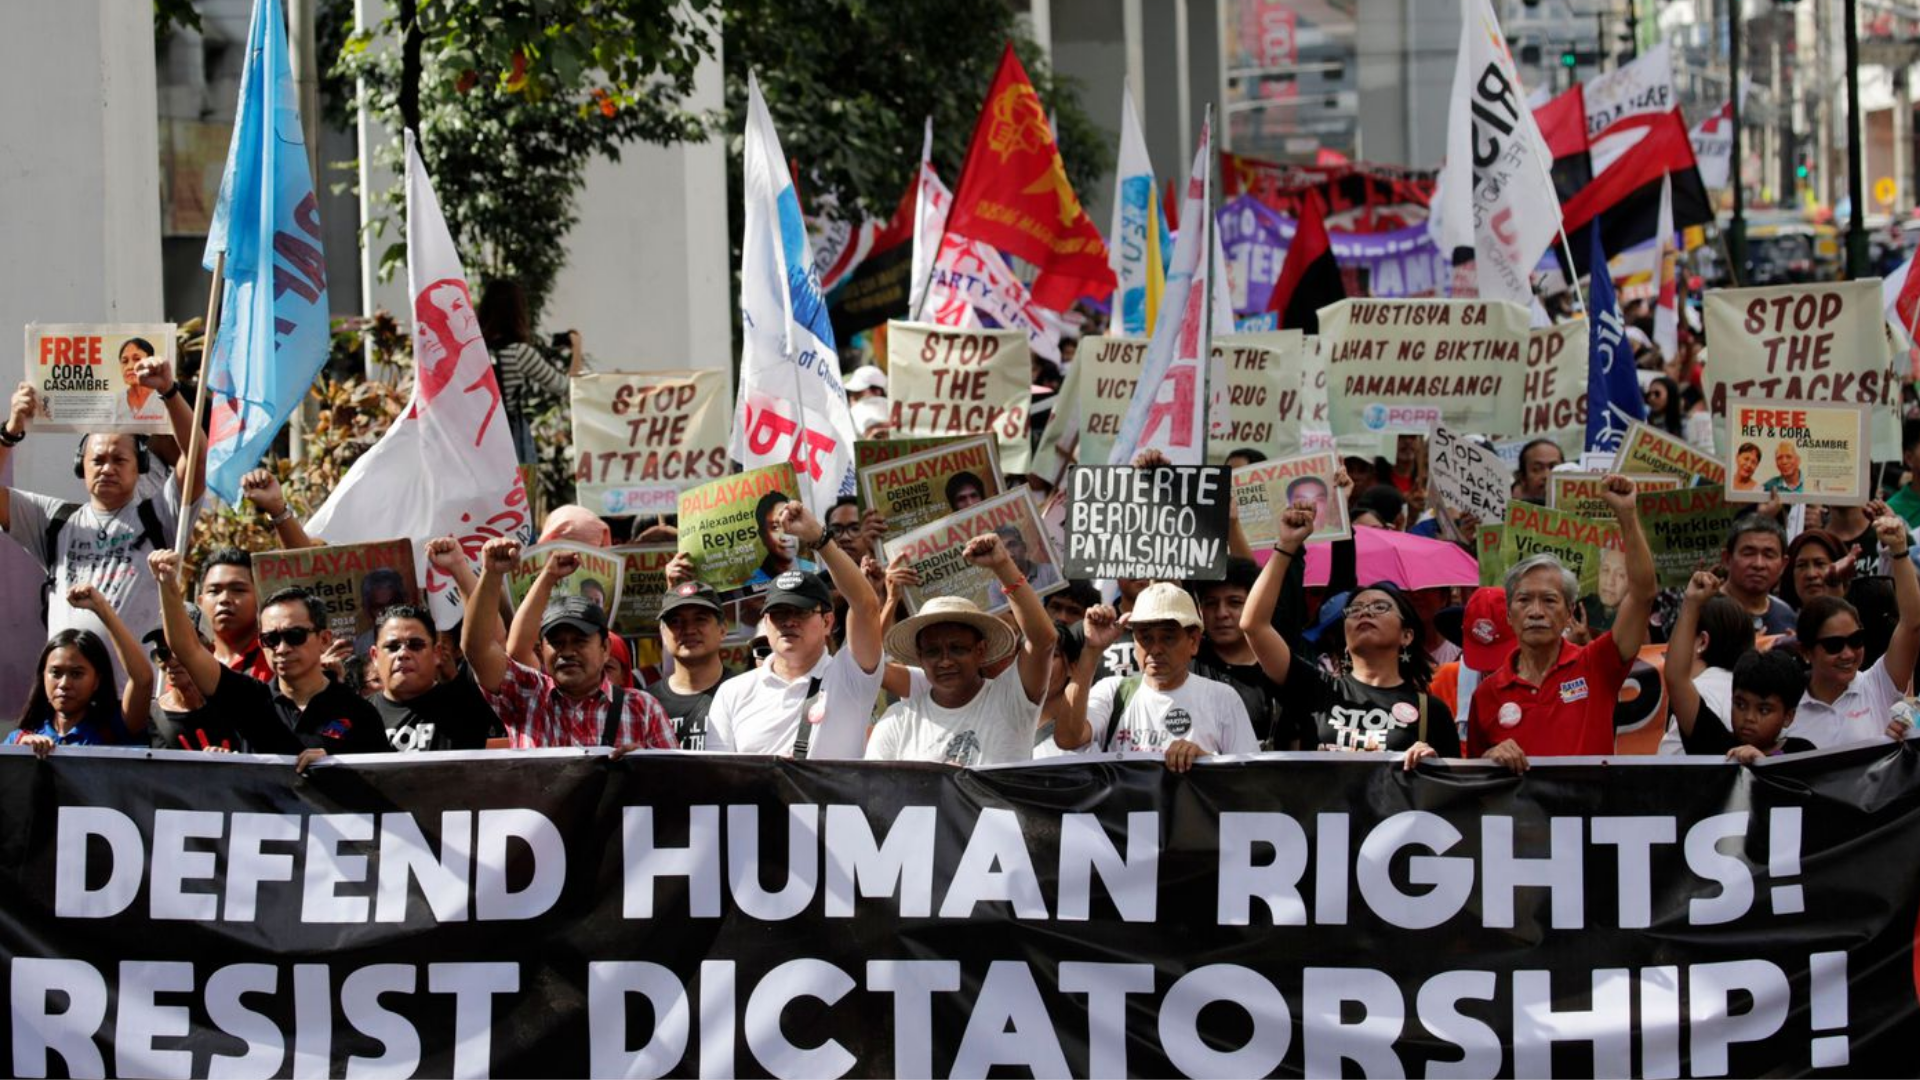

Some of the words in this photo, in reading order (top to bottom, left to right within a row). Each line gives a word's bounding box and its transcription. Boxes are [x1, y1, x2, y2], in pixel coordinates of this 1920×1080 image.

[1350, 304, 1450, 326] HUSTISYA
[1461, 304, 1487, 326] SA
[1744, 293, 1842, 334] STOP
[40, 337, 102, 365] FREE
[921, 331, 999, 366] STOP
[1331, 340, 1389, 363] LAHAT
[1397, 340, 1425, 361] NG
[1434, 340, 1519, 362] BIKTIMA
[1763, 332, 1834, 374] THE
[43, 379, 109, 391] CASAMBRE
[52, 365, 93, 379] CORA
[932, 368, 990, 400] THE
[611, 383, 697, 415] STOP
[627, 413, 690, 447] THE
[1740, 408, 1807, 428] FREE
[1742, 424, 1763, 437] REY
[1767, 427, 1775, 438] &
[1780, 427, 1812, 439] CORA
[1435, 427, 1482, 466] STOP
[1796, 439, 1849, 450] CASAMBRE
[576, 446, 727, 483] ATTACKS
[886, 482, 930, 501] DENNIS
[1074, 467, 1221, 505] DUTERTE
[892, 493, 932, 512] ORTIZ
[699, 509, 755, 533] Alexander
[1072, 503, 1196, 537] BERDUGO
[1654, 517, 1733, 537] Marklen
[702, 525, 758, 550] Reyes
[1070, 533, 1220, 569] PATALSIKIN!
[1666, 534, 1721, 551] Maga
[55, 806, 566, 923] DEFEND
[622, 803, 1158, 922] HUMAN
[1217, 805, 1804, 928] RIGHTS!
[10, 957, 519, 1080] RESIST
[588, 951, 1849, 1080] DICTATORSHIP!
